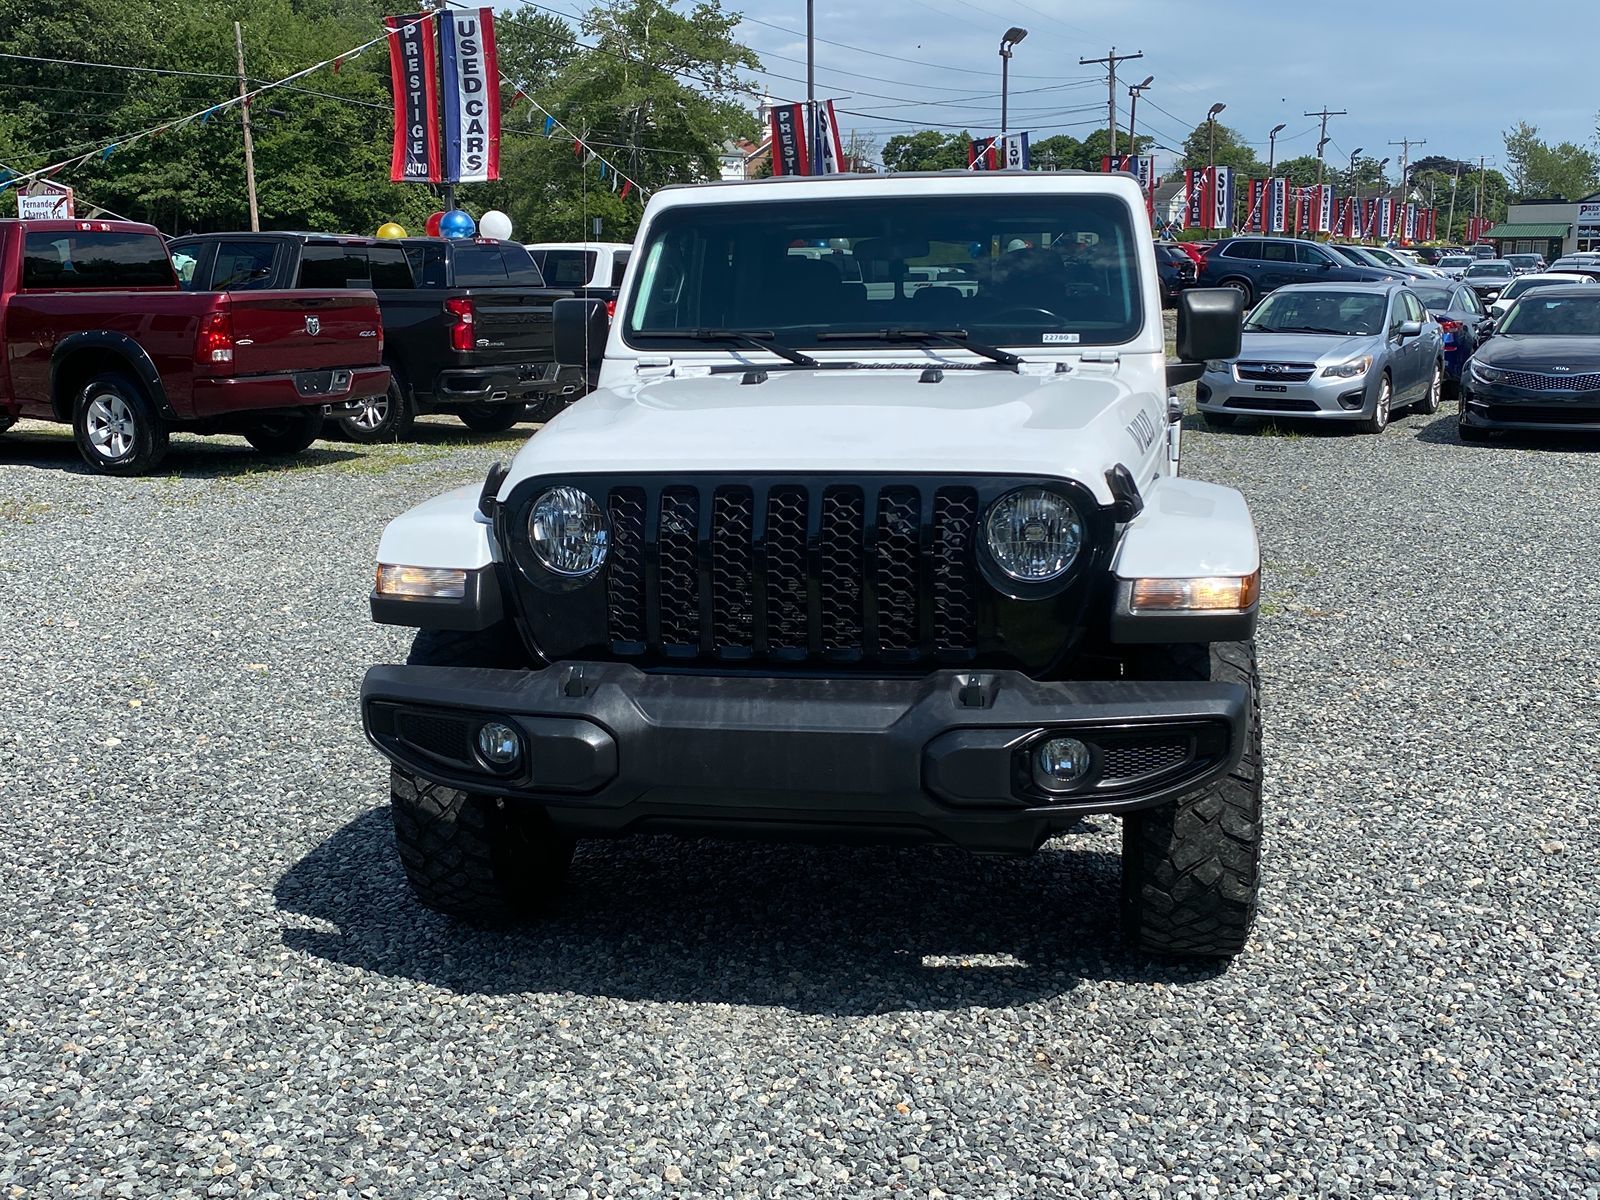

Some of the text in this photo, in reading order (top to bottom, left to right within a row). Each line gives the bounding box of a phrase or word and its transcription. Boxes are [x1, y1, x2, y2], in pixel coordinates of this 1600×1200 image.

[403, 25, 424, 154] PRESTIGE
[458, 20, 484, 171] USED CARS
[1009, 140, 1020, 166] LOW
[406, 162, 428, 175] AUTO
[1140, 160, 1149, 187] USED
[22, 199, 56, 209] Fernandes
[1217, 172, 1226, 222] SUV
[1275, 207, 1283, 229] CARS
